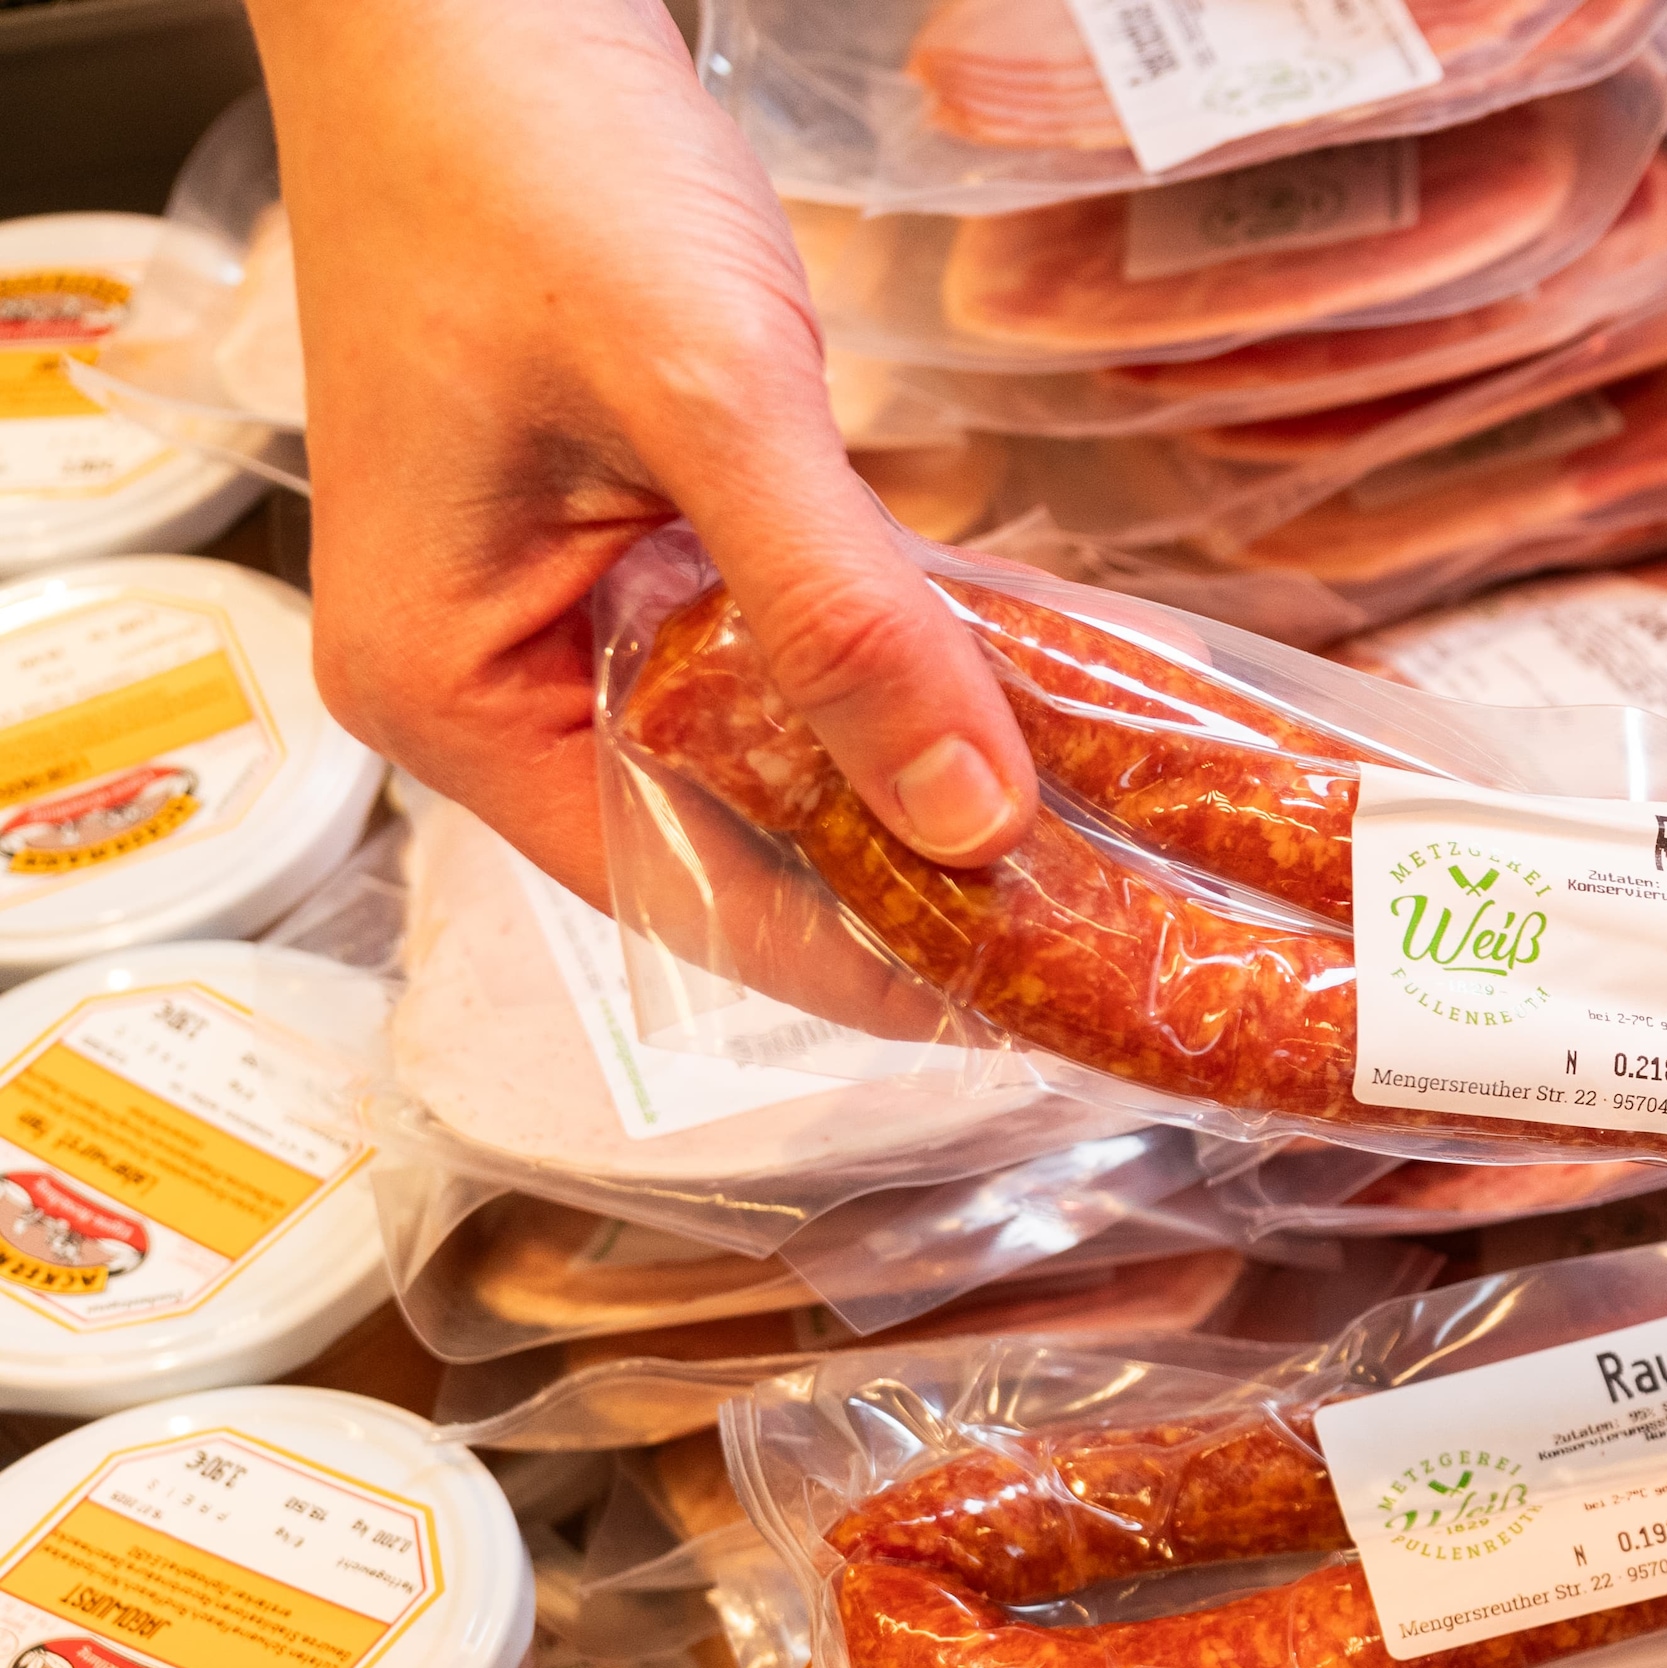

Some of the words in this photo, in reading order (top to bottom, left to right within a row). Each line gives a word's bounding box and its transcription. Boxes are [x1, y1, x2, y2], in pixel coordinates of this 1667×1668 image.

[1587, 869, 1660, 889] Zutaten:
[1389, 894, 1548, 970] Weiß
[1587, 1008, 1611, 1022] bei
[1370, 1066, 1532, 1100] Mengersreuther
[1535, 1084, 1568, 1103] Str.
[1573, 1088, 1597, 1107] 22
[1398, 1591, 1550, 1639] Mengersreuther
